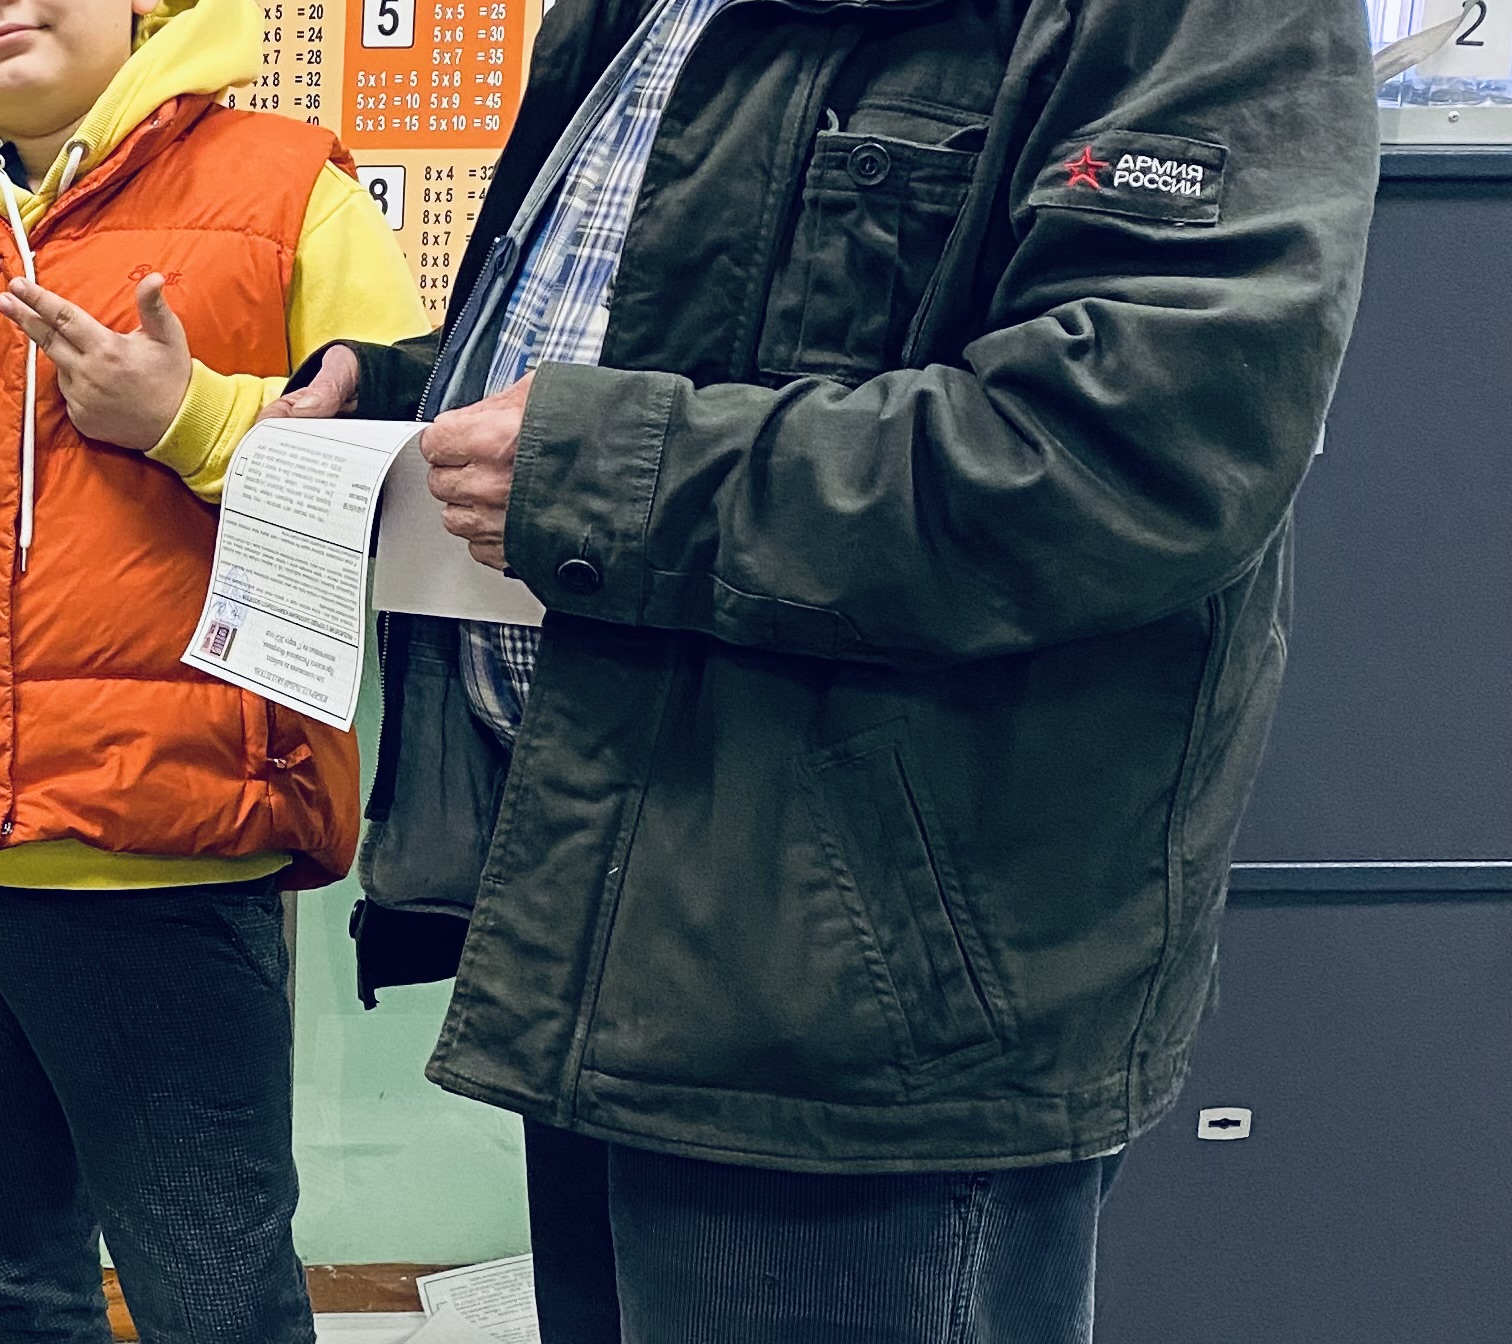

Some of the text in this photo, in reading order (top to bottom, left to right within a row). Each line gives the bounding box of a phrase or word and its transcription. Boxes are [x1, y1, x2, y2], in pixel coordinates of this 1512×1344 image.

[433, 26, 442, 43] 5
[455, 26, 464, 43] 6
[489, 25, 505, 42] 30
[357, 71, 366, 87] 5
[380, 71, 386, 87] 1
[409, 70, 418, 87] 5
[431, 70, 440, 87] 5
[453, 70, 461, 87] 8
[486, 70, 503, 87] 40
[249, 93, 258, 110] 4
[271, 93, 280, 110] 9
[305, 93, 321, 110] 36
[355, 115, 364, 132] 5
[377, 115, 386, 131] 3
[404, 115, 419, 131] 15
[428, 115, 437, 131] 5
[451, 115, 467, 131] 10
[484, 114, 500, 131] 50
[424, 165, 432, 182] 8
[446, 165, 455, 181] 4
[1116, 153, 1204, 182] АРМИЯ
[1113, 170, 1201, 197] РОССИИ
[422, 209, 430, 225] 8
[444, 209, 453, 225] 6
[420, 252, 428, 268] 8
[442, 252, 450, 268] 8
[419, 274, 427, 290] 8
[441, 273, 449, 289] 9
